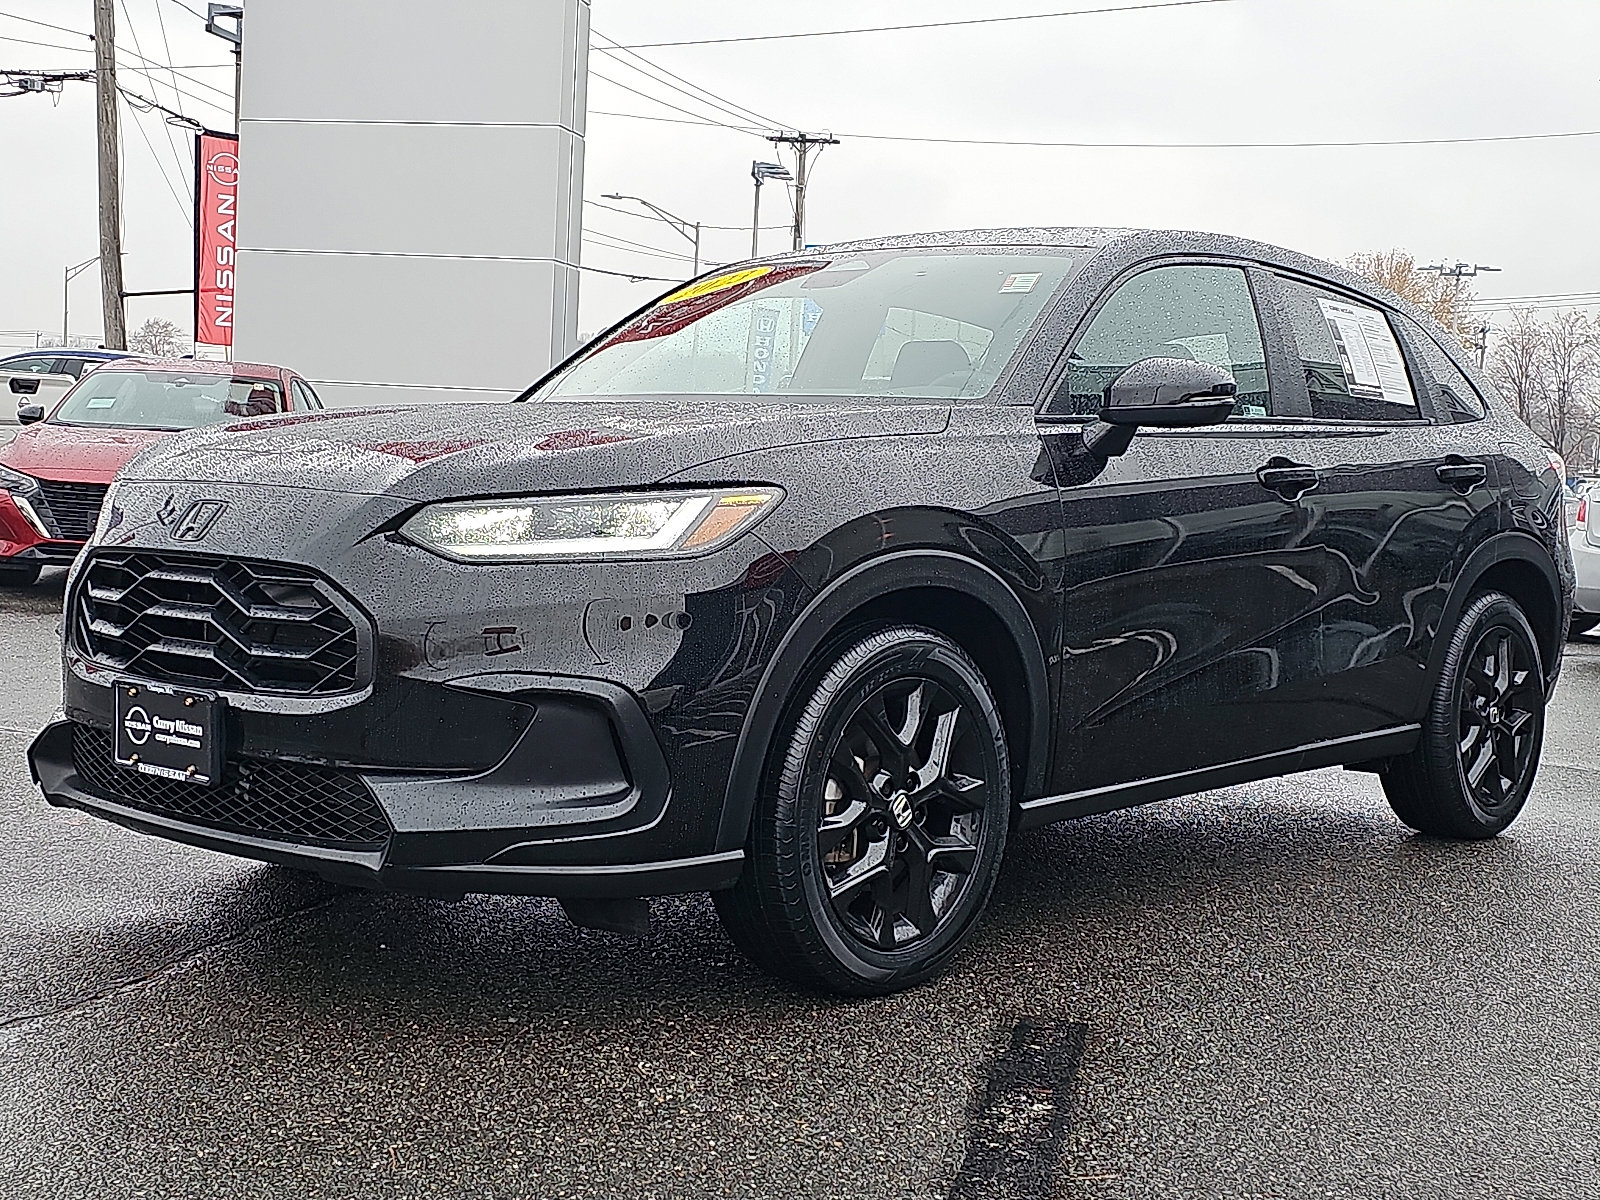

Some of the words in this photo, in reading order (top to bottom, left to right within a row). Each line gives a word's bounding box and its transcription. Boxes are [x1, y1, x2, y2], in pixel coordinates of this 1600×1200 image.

[206, 163, 240, 175] NISSA
[214, 193, 236, 328] NISSAN
[152, 715, 176, 734] Curry
[175, 719, 203, 737] Nissan
